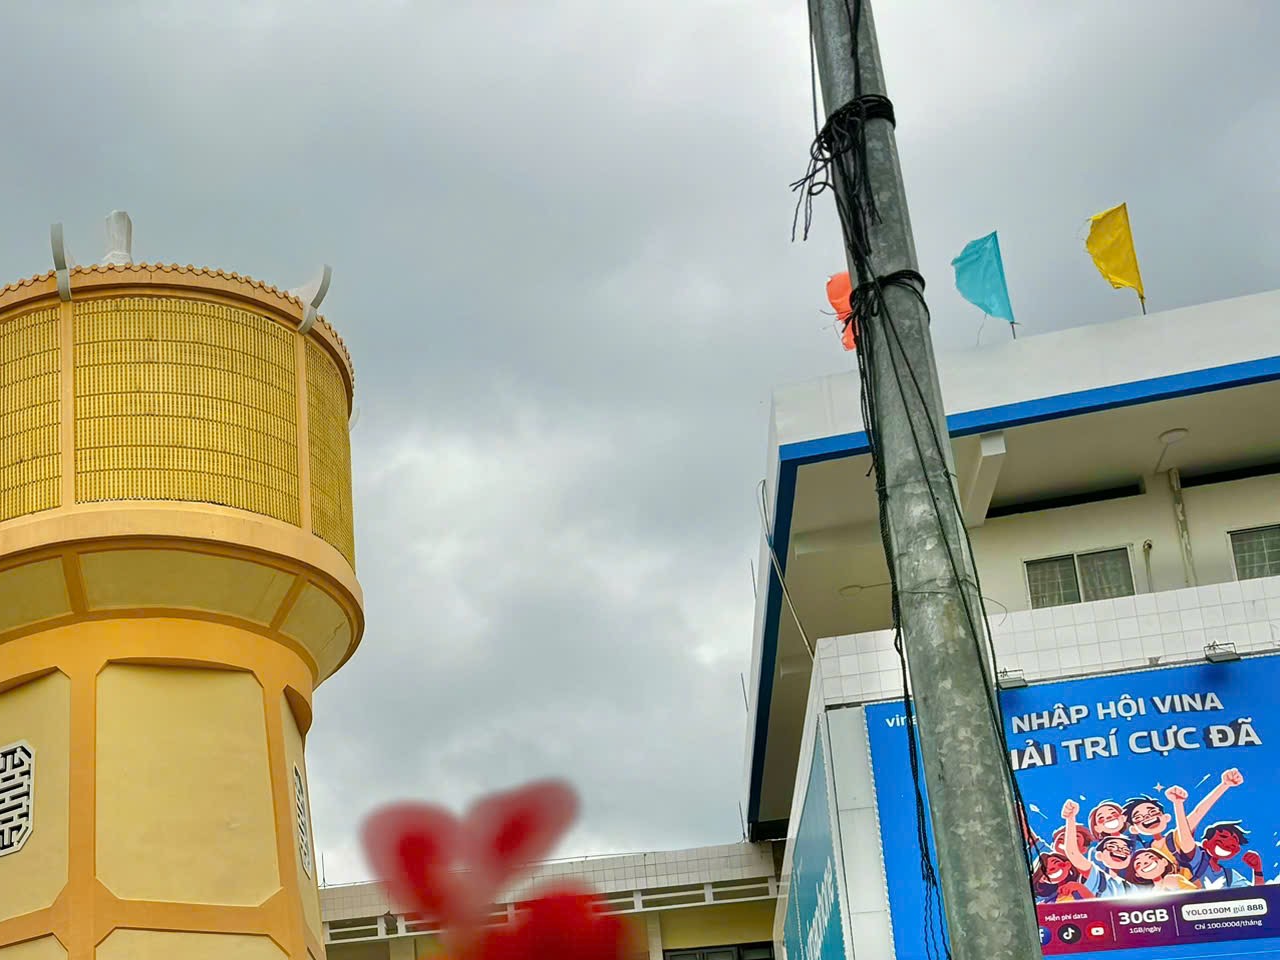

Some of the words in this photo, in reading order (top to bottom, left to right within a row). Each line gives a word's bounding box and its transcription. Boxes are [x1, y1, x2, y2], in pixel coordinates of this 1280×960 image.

[1011, 703, 1089, 734] NHẬP
[1096, 694, 1147, 721] HỘI
[1152, 692, 1225, 714] VINA
[1010, 739, 1054, 771] IẢI
[1061, 728, 1118, 762] TRÍ
[1128, 725, 1201, 756] CỰC
[1208, 717, 1263, 748] ĐÃ
[1246, 903, 1264, 912] 888
[1061, 914, 1072, 922] phí
[1072, 912, 1088, 920] data
[1117, 908, 1169, 925] 30GB
